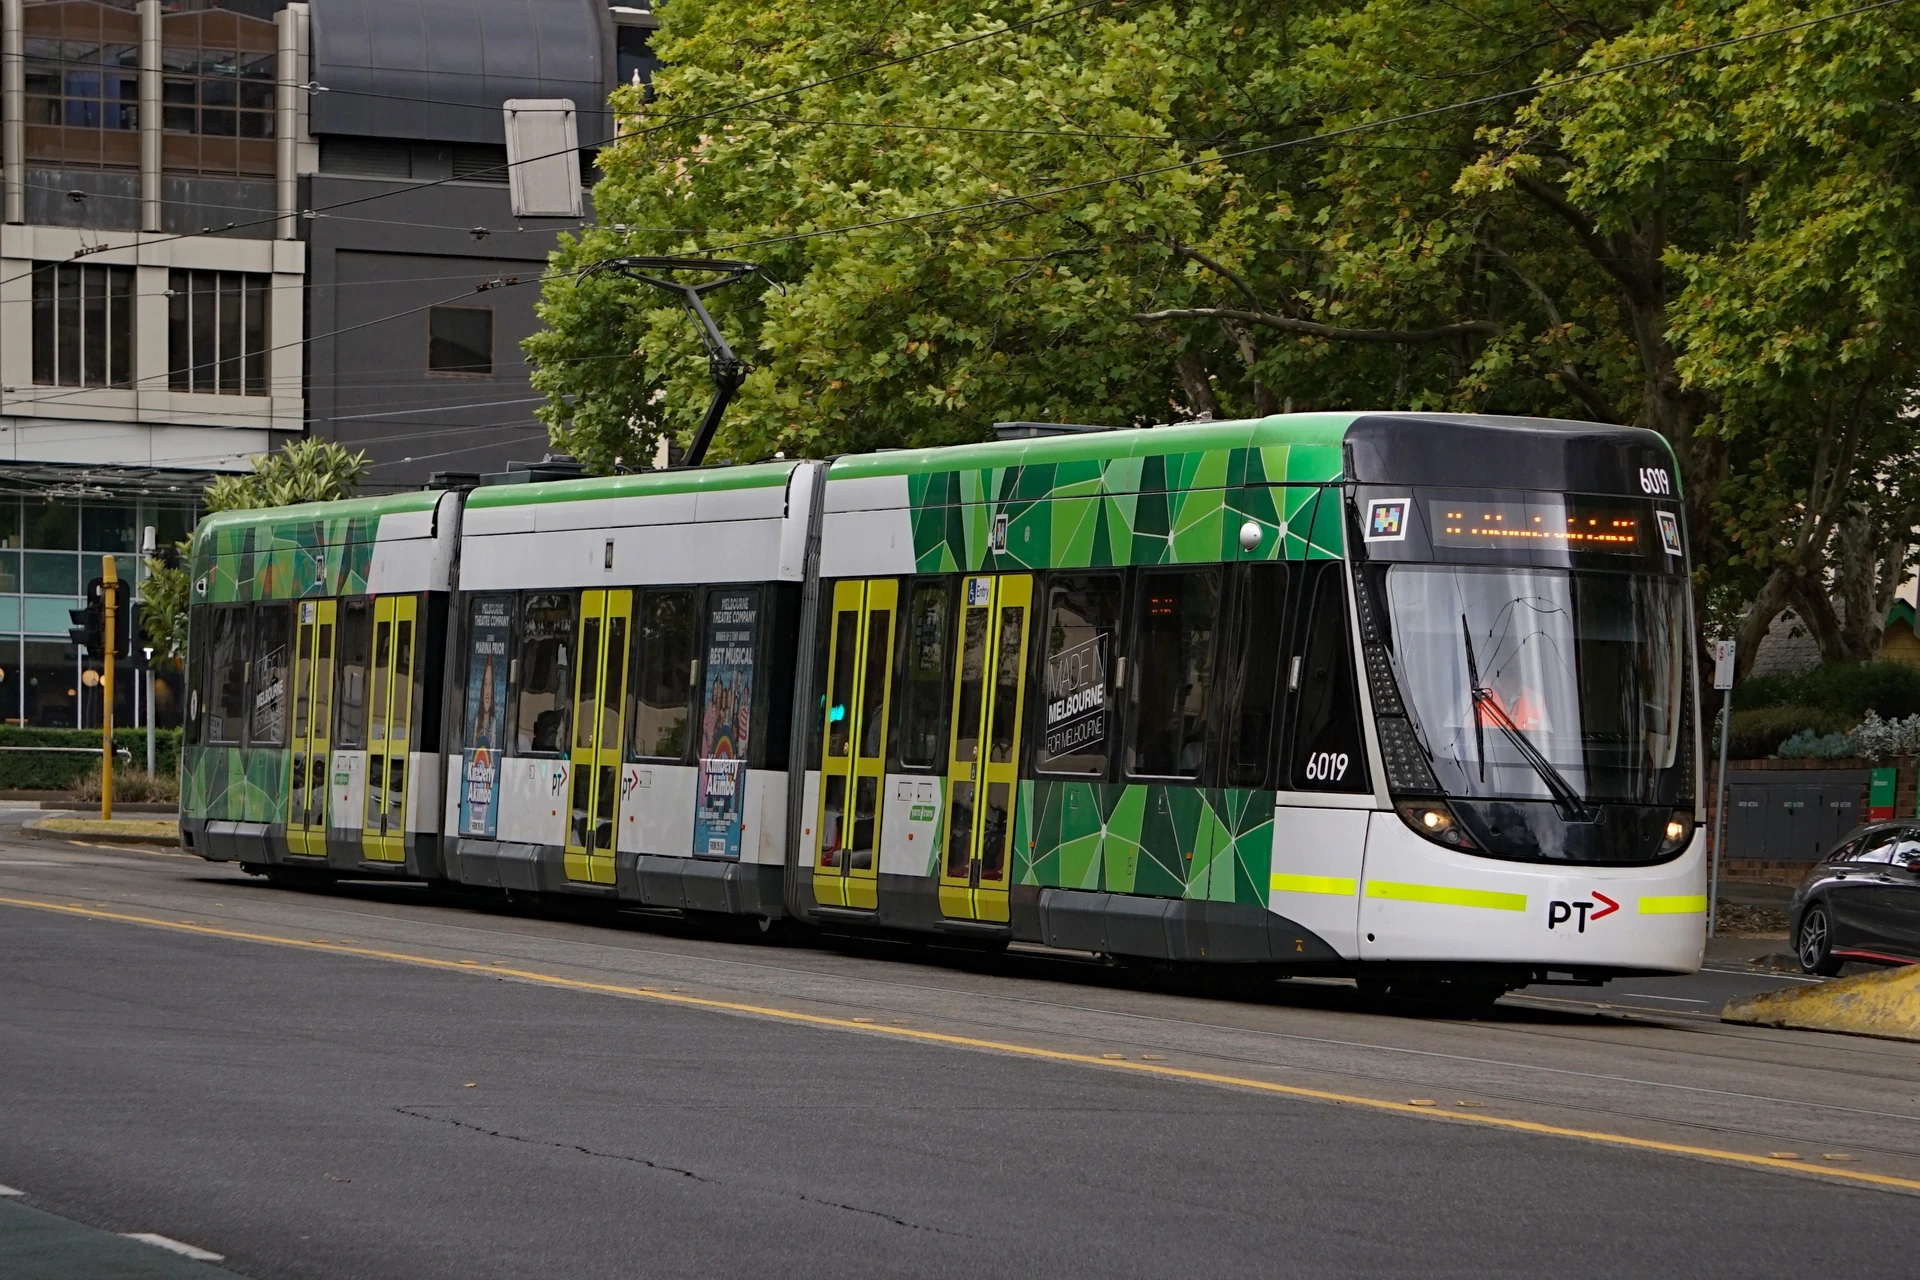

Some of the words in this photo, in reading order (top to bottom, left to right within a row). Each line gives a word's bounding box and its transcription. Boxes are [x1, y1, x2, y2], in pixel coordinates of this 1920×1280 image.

[1640, 467, 1669, 495] 6019
[721, 597, 749, 610] MELBOURNE
[976, 585, 989, 600] Entry
[712, 610, 732, 623] THEATRE
[732, 610, 756, 623] COMPANY
[710, 647, 725, 665] BEST
[724, 647, 753, 665] MUSICAL
[1048, 647, 1090, 700] MADE
[1048, 682, 1104, 725] MELBOURNE
[1047, 733, 1061, 754] FOR
[1061, 715, 1103, 750] MELBOURNE
[706, 753, 739, 781] Kimberly
[1306, 751, 1349, 781] 6019
[706, 773, 736, 797] Akimbo
